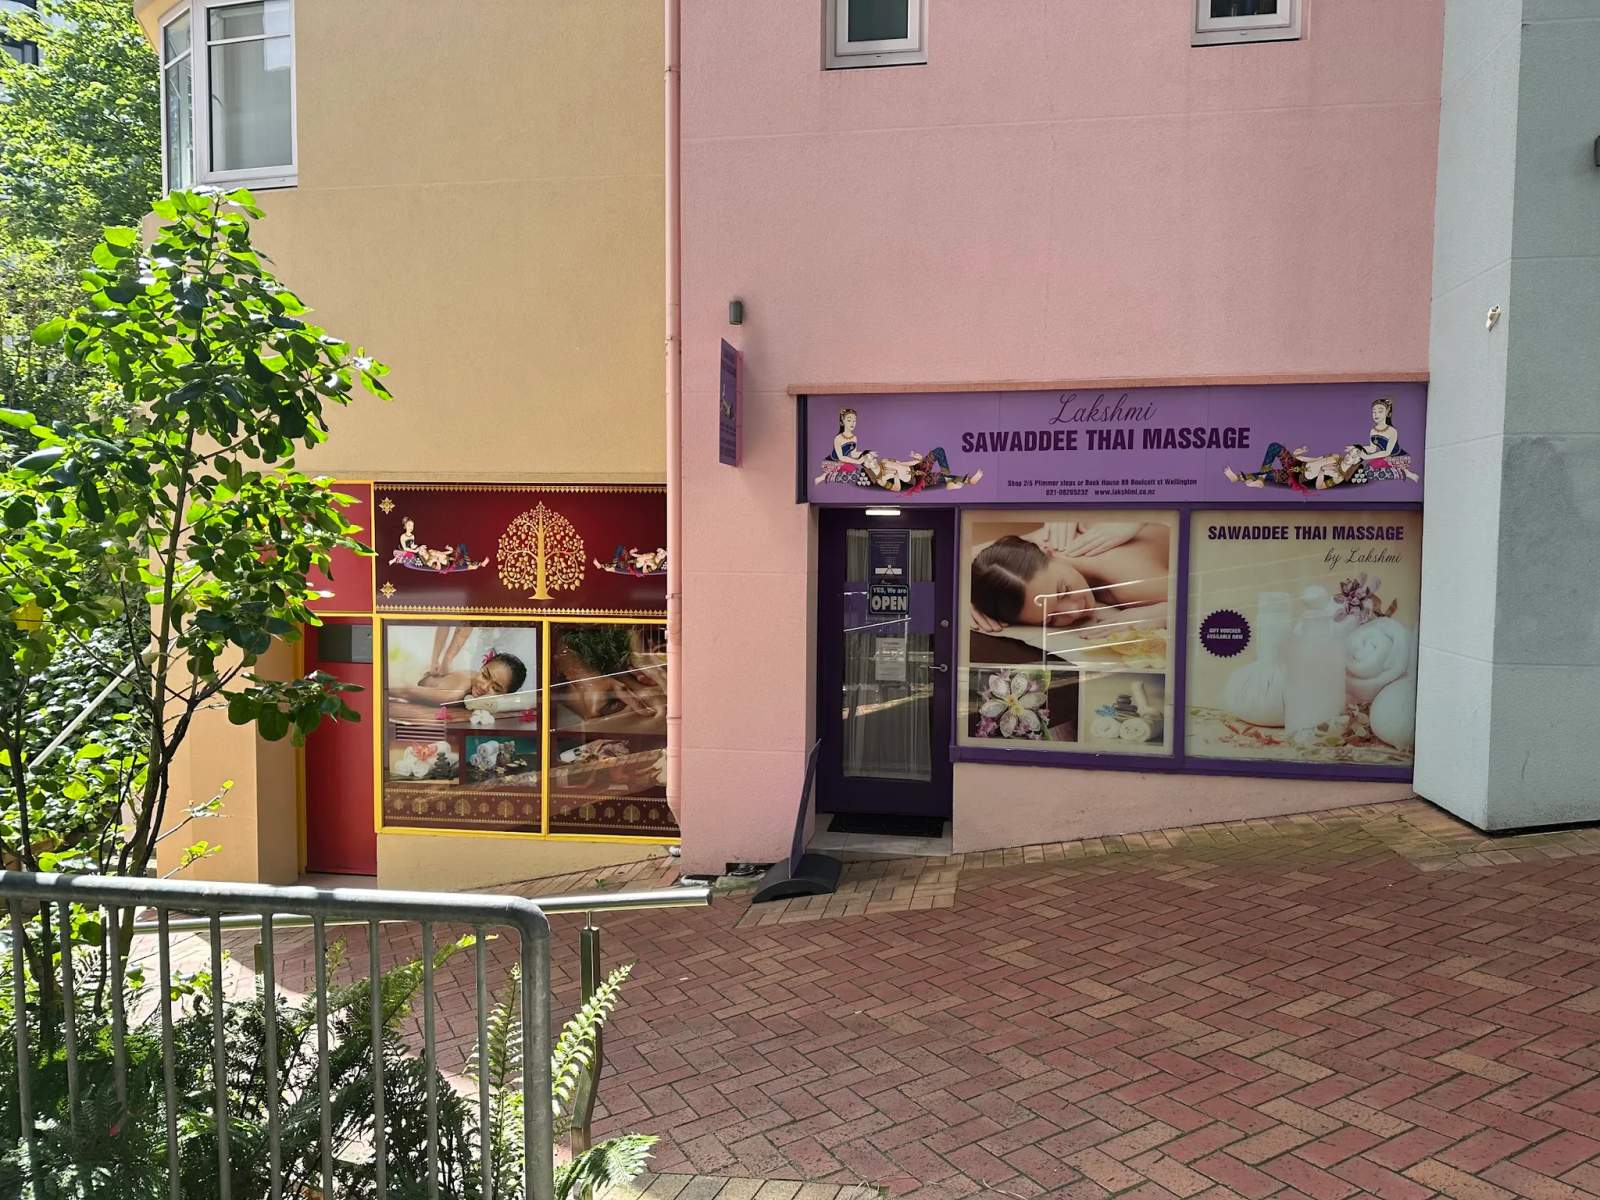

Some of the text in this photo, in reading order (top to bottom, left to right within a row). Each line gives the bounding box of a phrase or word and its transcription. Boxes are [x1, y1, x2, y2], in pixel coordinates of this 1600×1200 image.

[1050, 393, 1157, 425] Lakshmi
[962, 427, 1250, 453] SAWADDEE THAI MASSAGE
[1007, 479, 1022, 487] Shop
[1060, 479, 1076, 487] steps
[1164, 478, 1198, 487] Wellington
[1208, 526, 1404, 541] SAWADDEE THAI MASSAGE
[1324, 546, 1402, 570] by Lakshmi
[872, 595, 907, 611] OPEN
